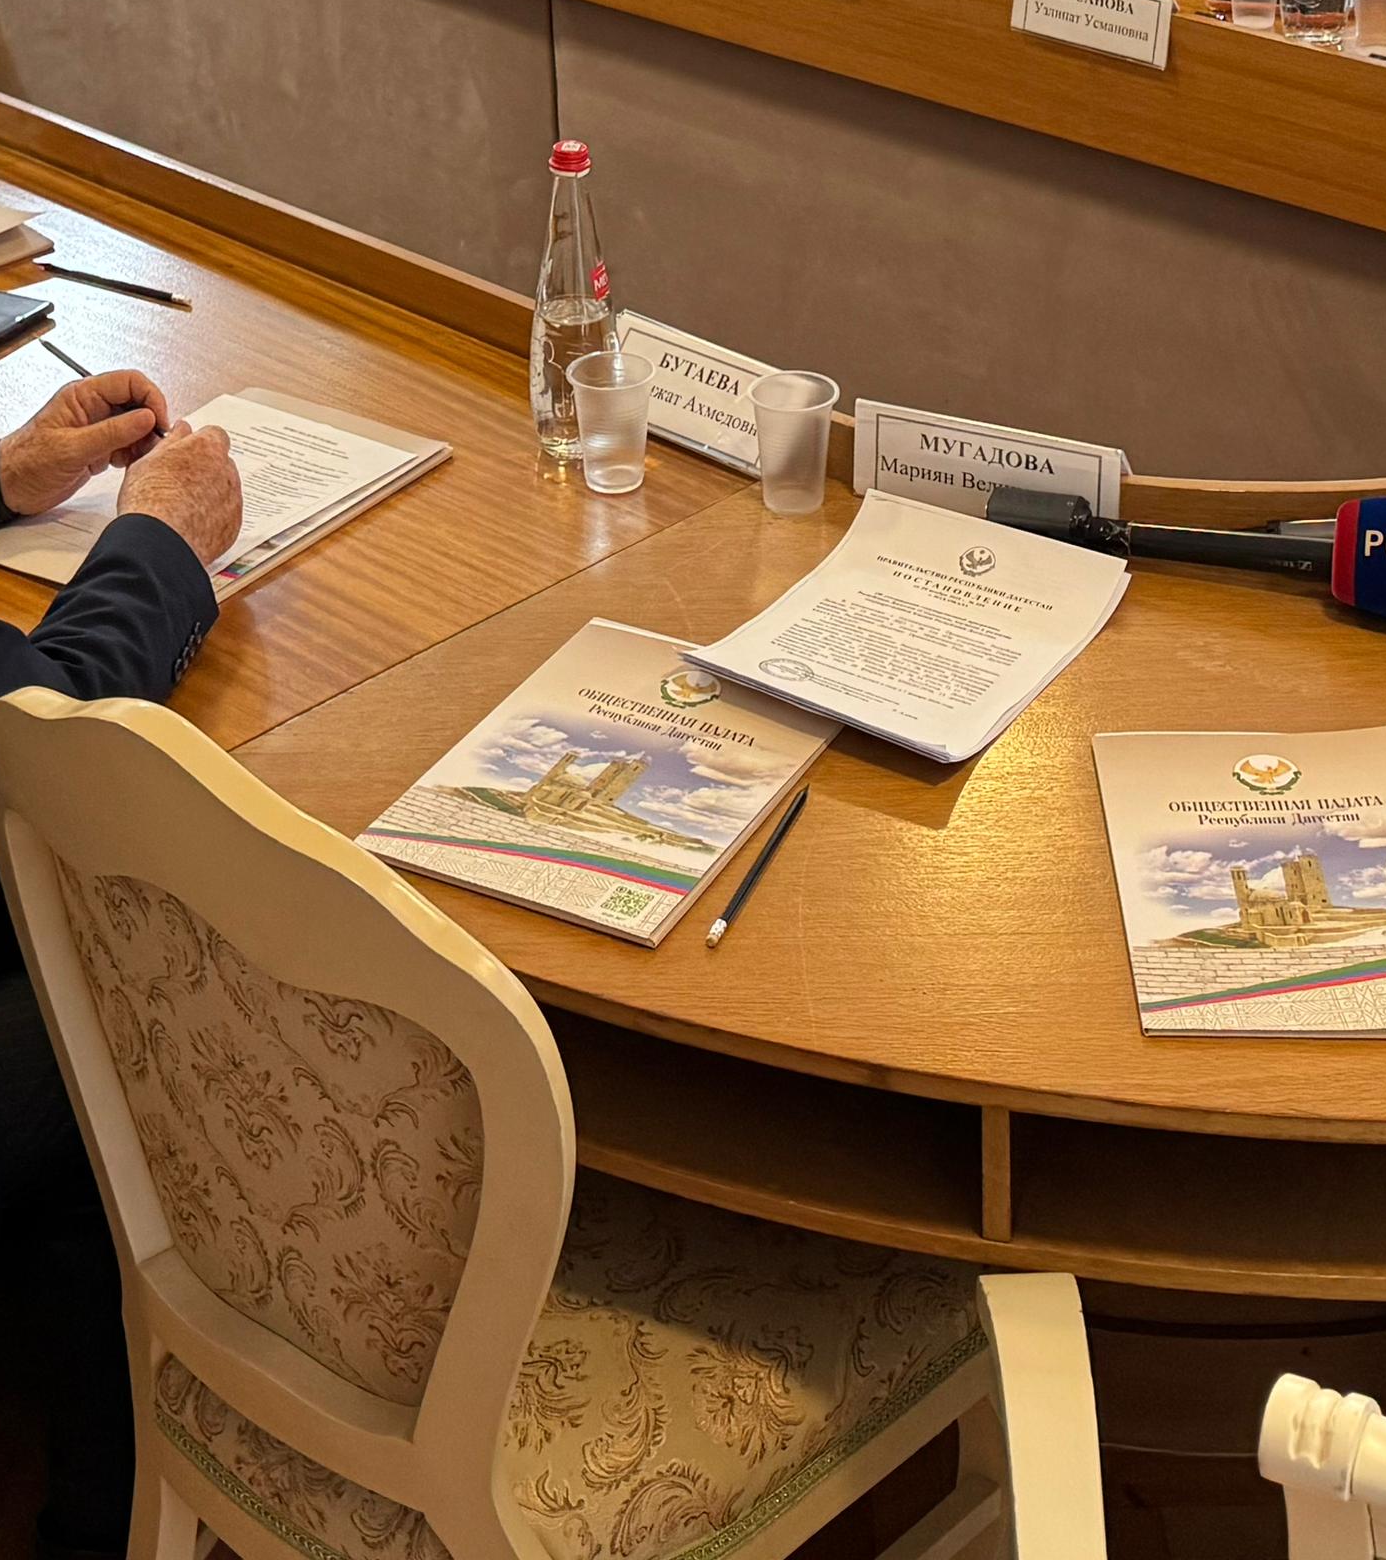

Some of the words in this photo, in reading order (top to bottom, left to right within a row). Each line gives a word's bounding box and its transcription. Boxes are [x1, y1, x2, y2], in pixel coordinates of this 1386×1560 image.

[1085, 12, 1149, 42] Усмановна
[658, 351, 741, 397] БУТАЕВА
[682, 395, 759, 438] Ахмедовн
[880, 454, 955, 486] Мариян
[919, 432, 1056, 476] МУГАДОВА
[577, 687, 698, 728] ОБЩЕСТВЕННАЯ
[698, 721, 756, 748] ПАЛАТА
[588, 702, 663, 733] Республики
[661, 724, 723, 752] Дагестан
[1168, 797, 1312, 815] ОБЩЕСТВЕННАЯ
[1317, 794, 1384, 810] ПАЛАТА
[1197, 812, 1287, 828] Республики
[1291, 811, 1361, 827] Дагестан
